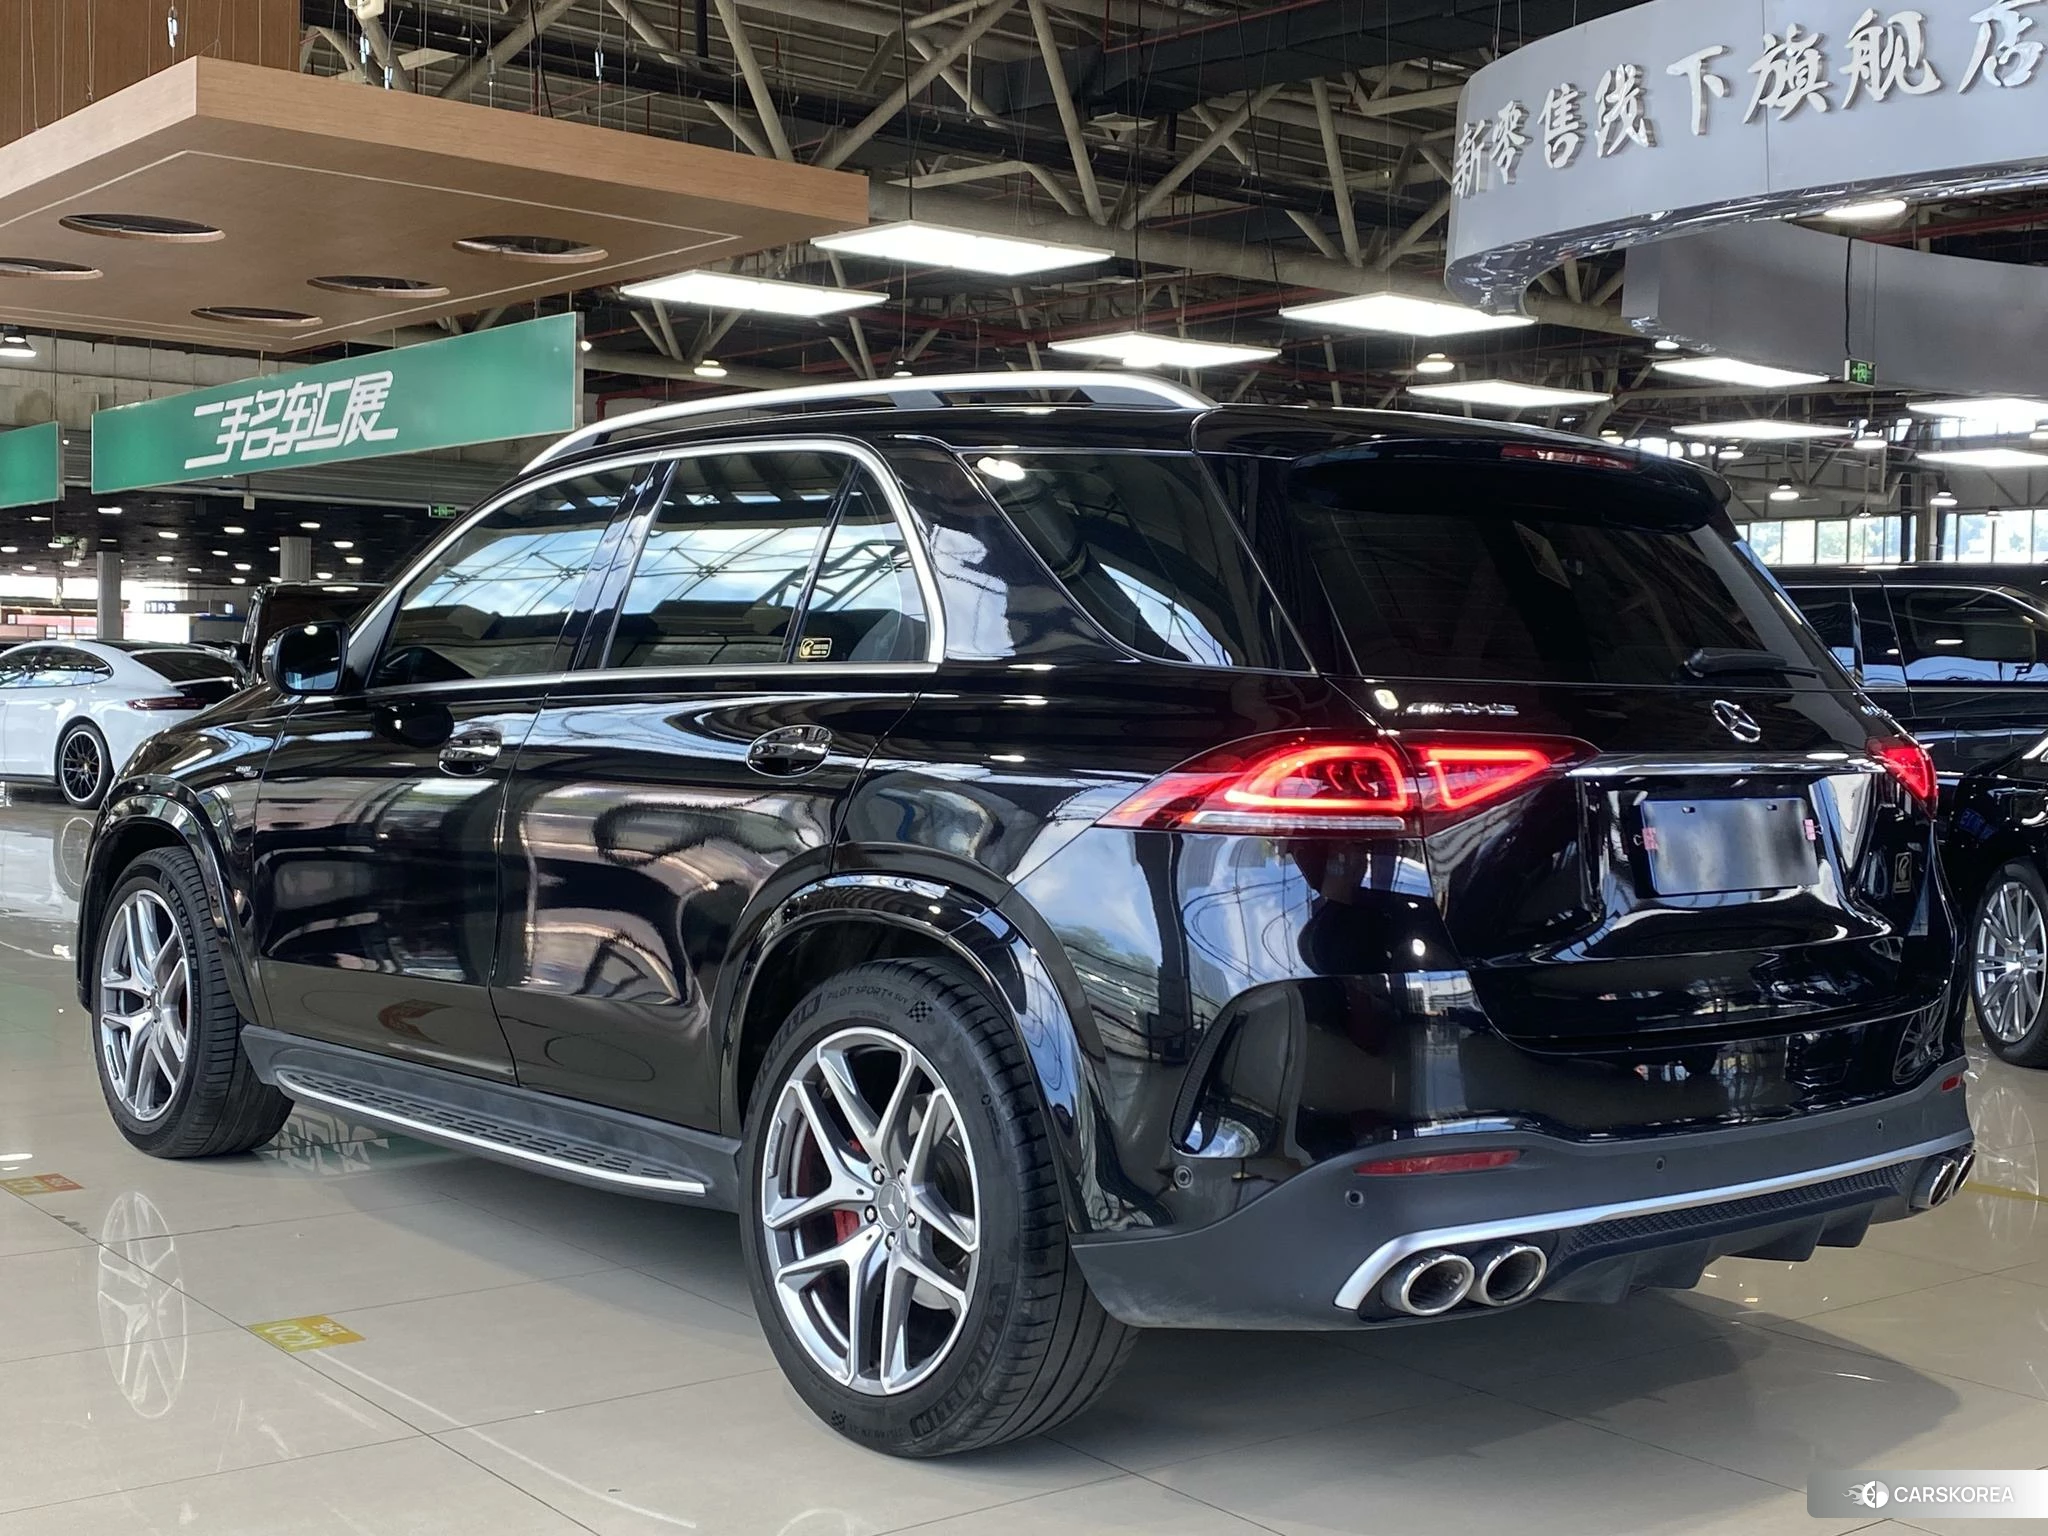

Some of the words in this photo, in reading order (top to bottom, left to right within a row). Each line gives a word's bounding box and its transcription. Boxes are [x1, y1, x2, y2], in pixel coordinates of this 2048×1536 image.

[1452, 0, 2048, 199] 新零售线下旗舰店
[856, 985, 888, 998] SPORT
